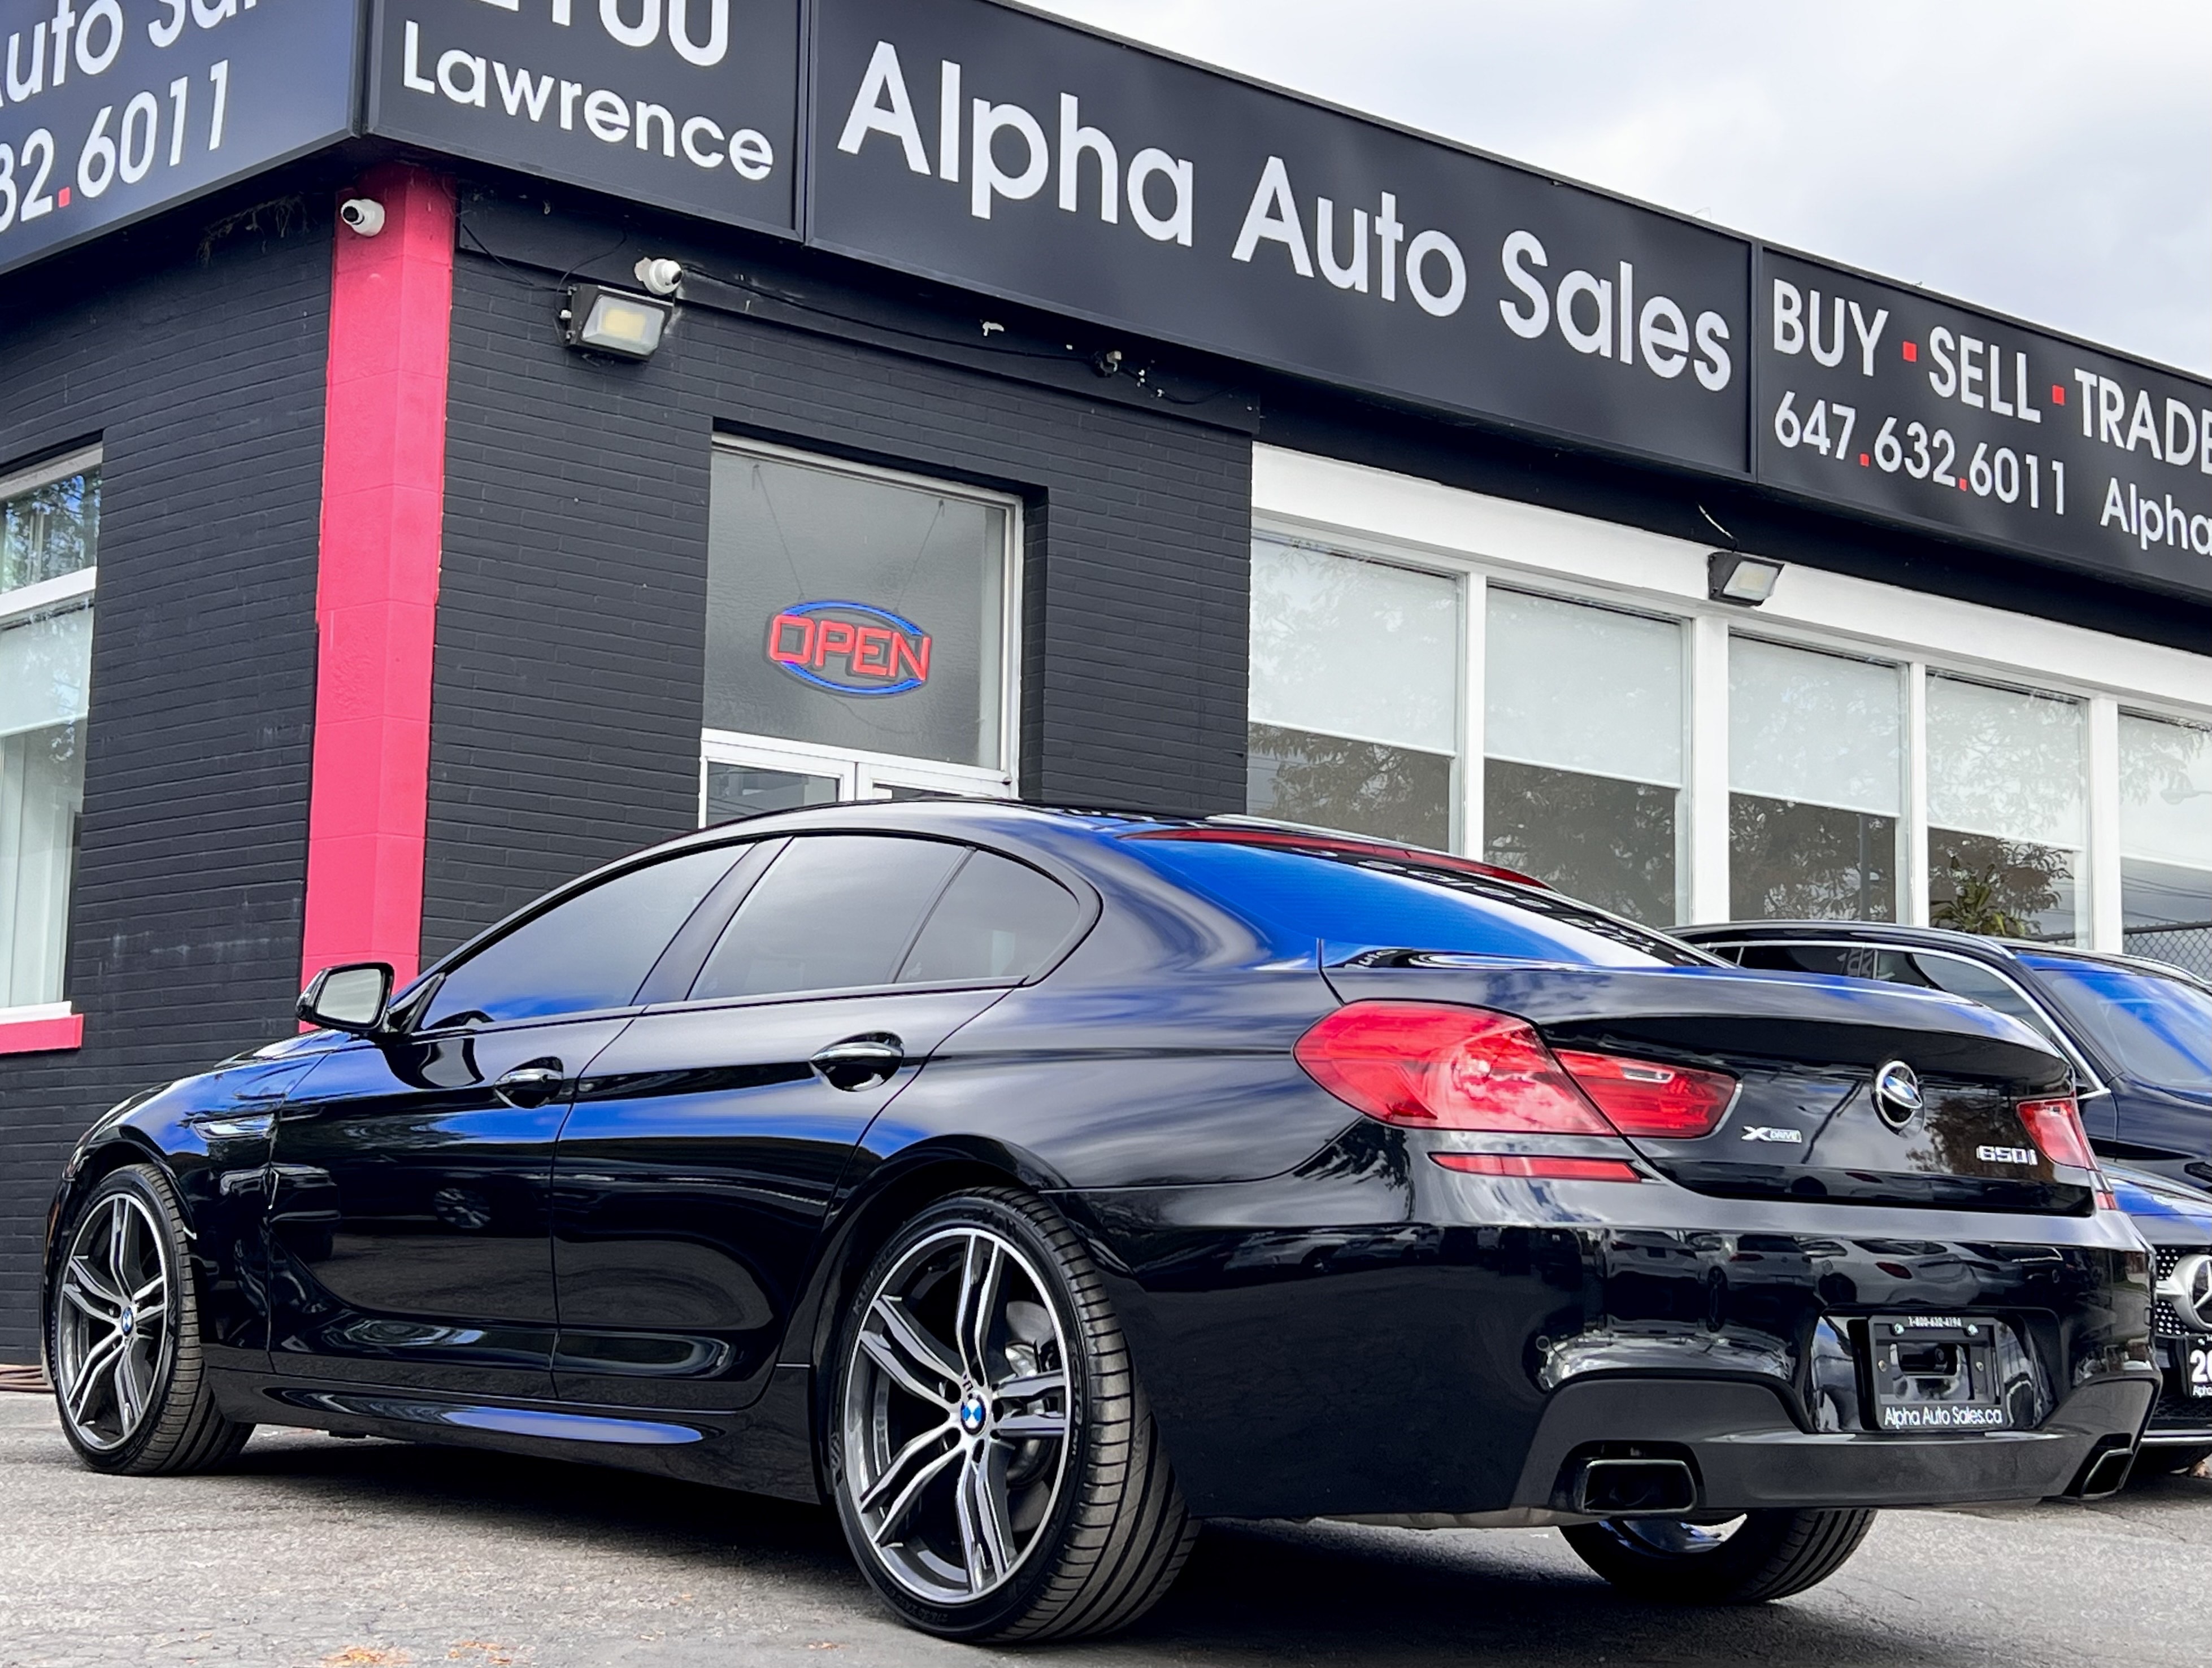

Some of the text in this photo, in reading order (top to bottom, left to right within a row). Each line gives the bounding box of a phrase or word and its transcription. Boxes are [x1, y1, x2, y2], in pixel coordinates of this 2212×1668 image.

[0, 0, 123, 107] uto
[403, 20, 773, 181] Lawrence
[837, 41, 1731, 391] Alpha Auto Sales
[1773, 278, 1889, 377] BUY
[1928, 326, 2041, 423] SELL
[1774, 391, 2065, 515] 647.632.6011
[2100, 477, 2212, 557] Alpha
[768, 613, 932, 682] OPEN
[1884, 1405, 2003, 1429] Alpha Auto Sales.ca
